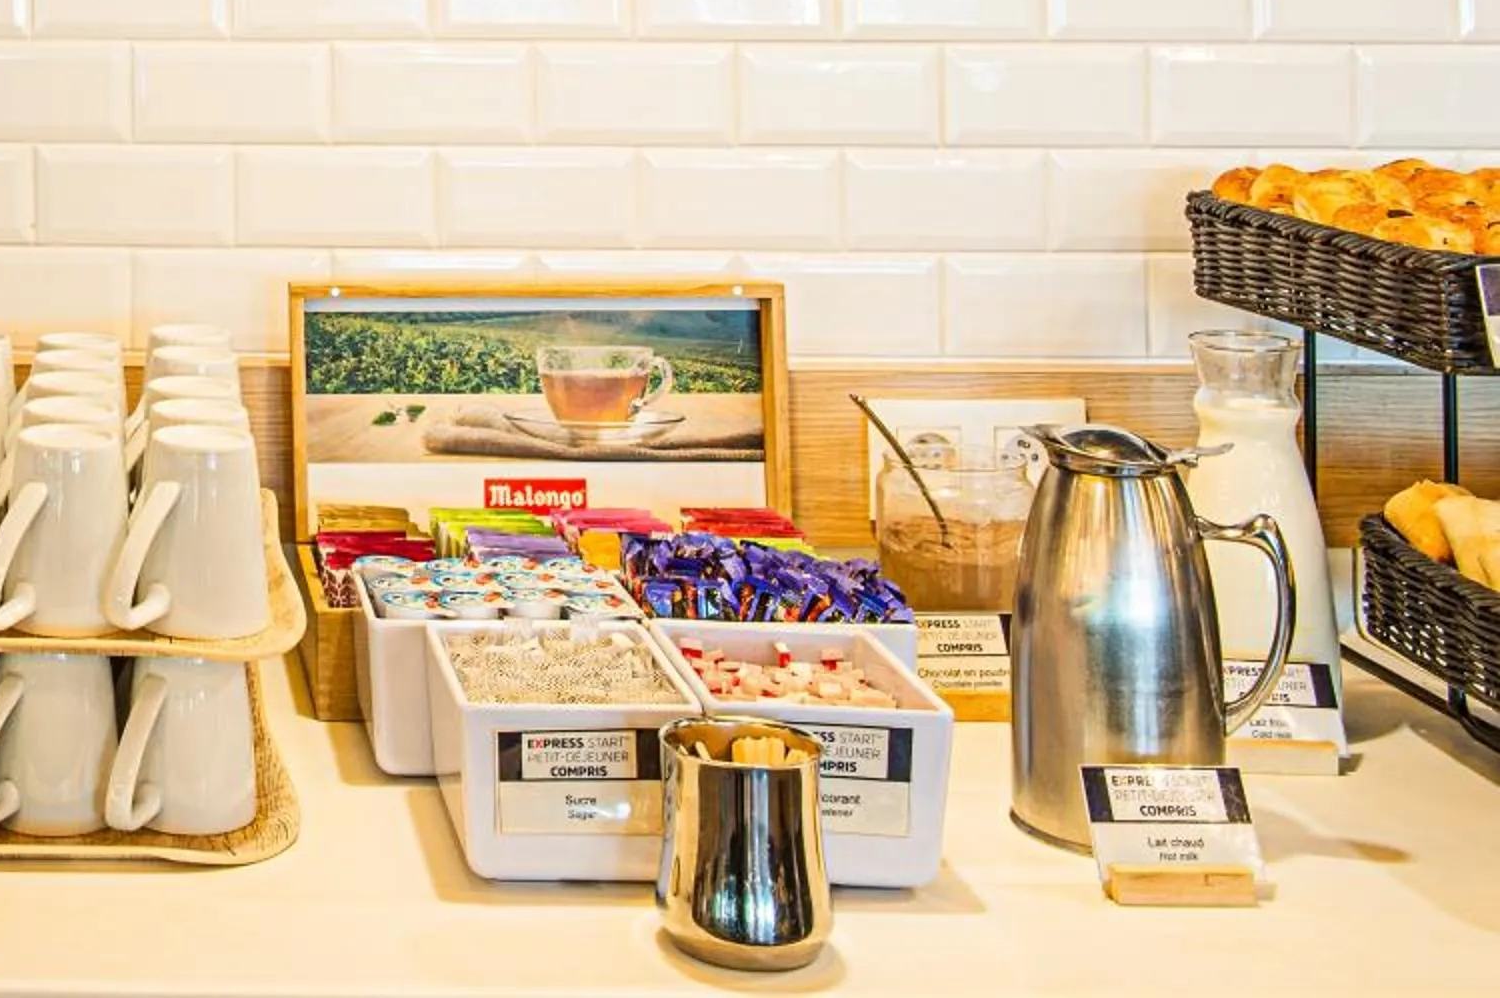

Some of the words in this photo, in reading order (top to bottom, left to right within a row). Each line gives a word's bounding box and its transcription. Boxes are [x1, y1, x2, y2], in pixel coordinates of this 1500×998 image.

[488, 484, 585, 509] Malongo
[936, 643, 983, 652] COMPRIS
[527, 737, 584, 750] EXPRESS
[550, 765, 608, 777] COMPRIS
[565, 794, 596, 805] Sucre
[1139, 805, 1197, 817] COMPRIS
